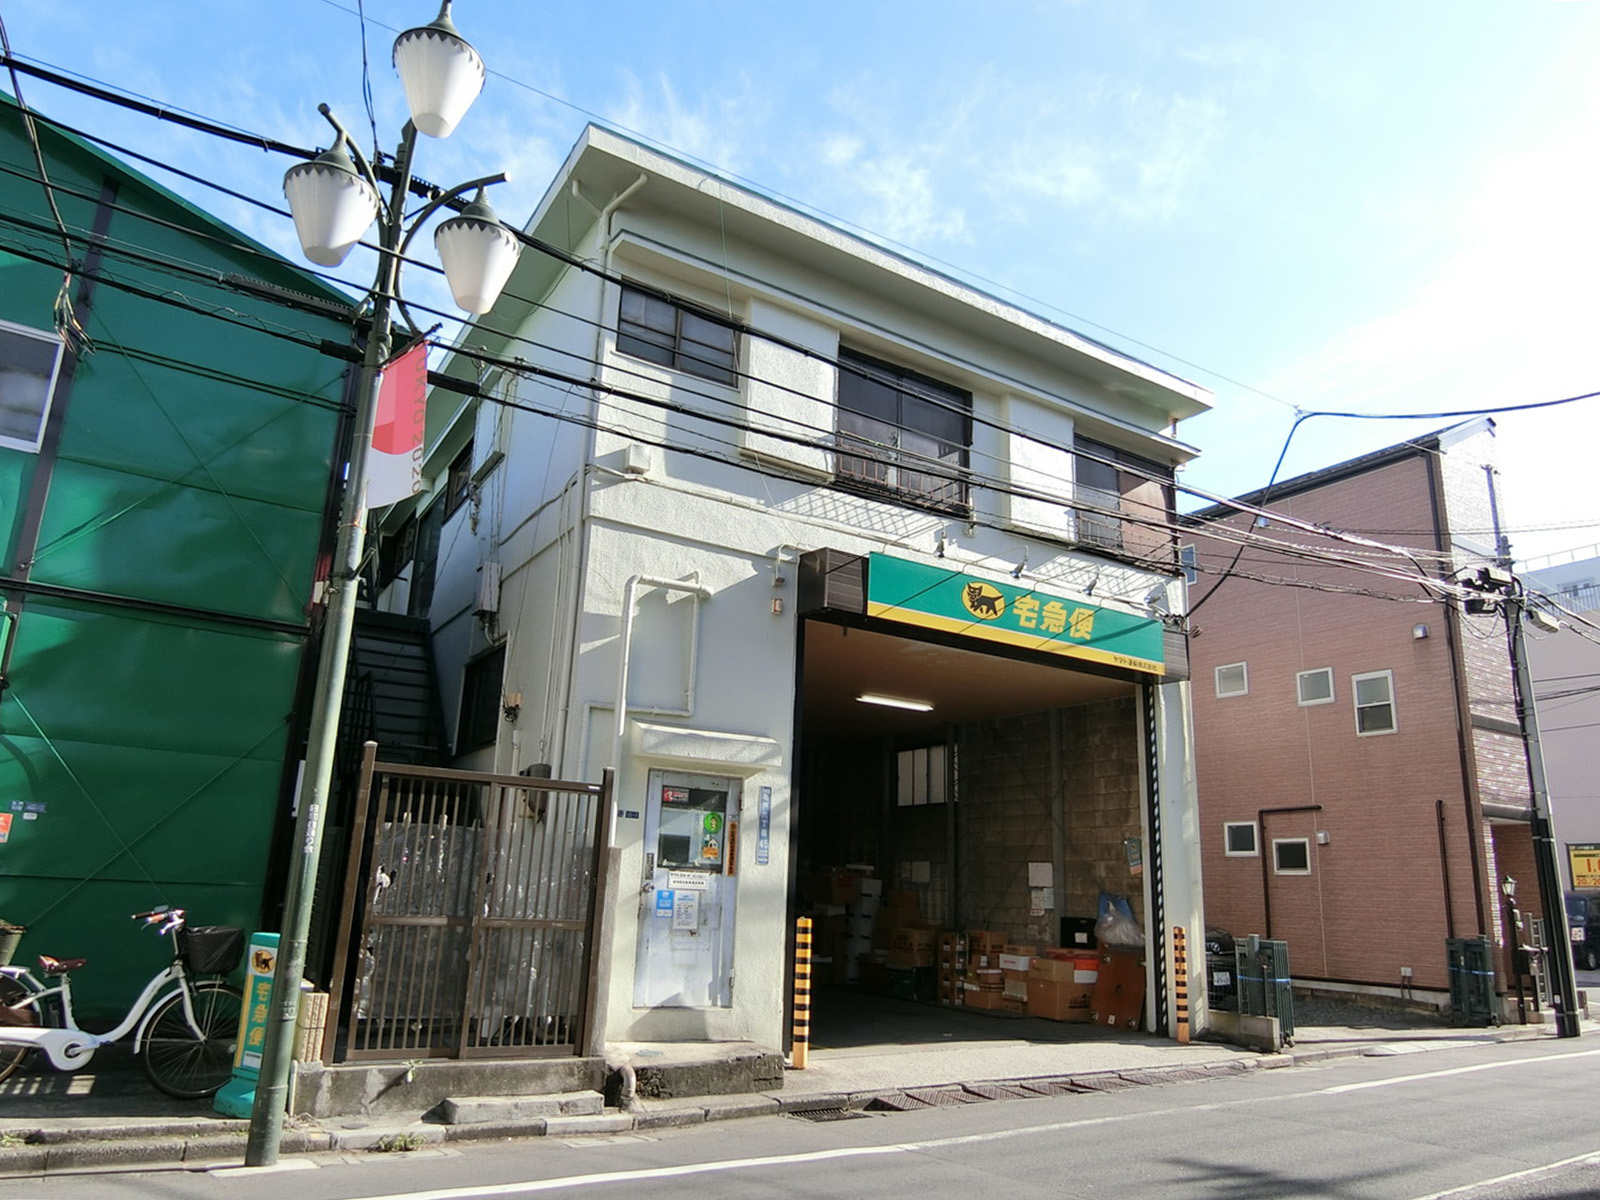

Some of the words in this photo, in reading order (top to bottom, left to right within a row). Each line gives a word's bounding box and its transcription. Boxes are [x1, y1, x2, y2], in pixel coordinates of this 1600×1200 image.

[1013, 595, 1095, 641] 宅急便
[249, 982, 272, 1046] 宅急便
